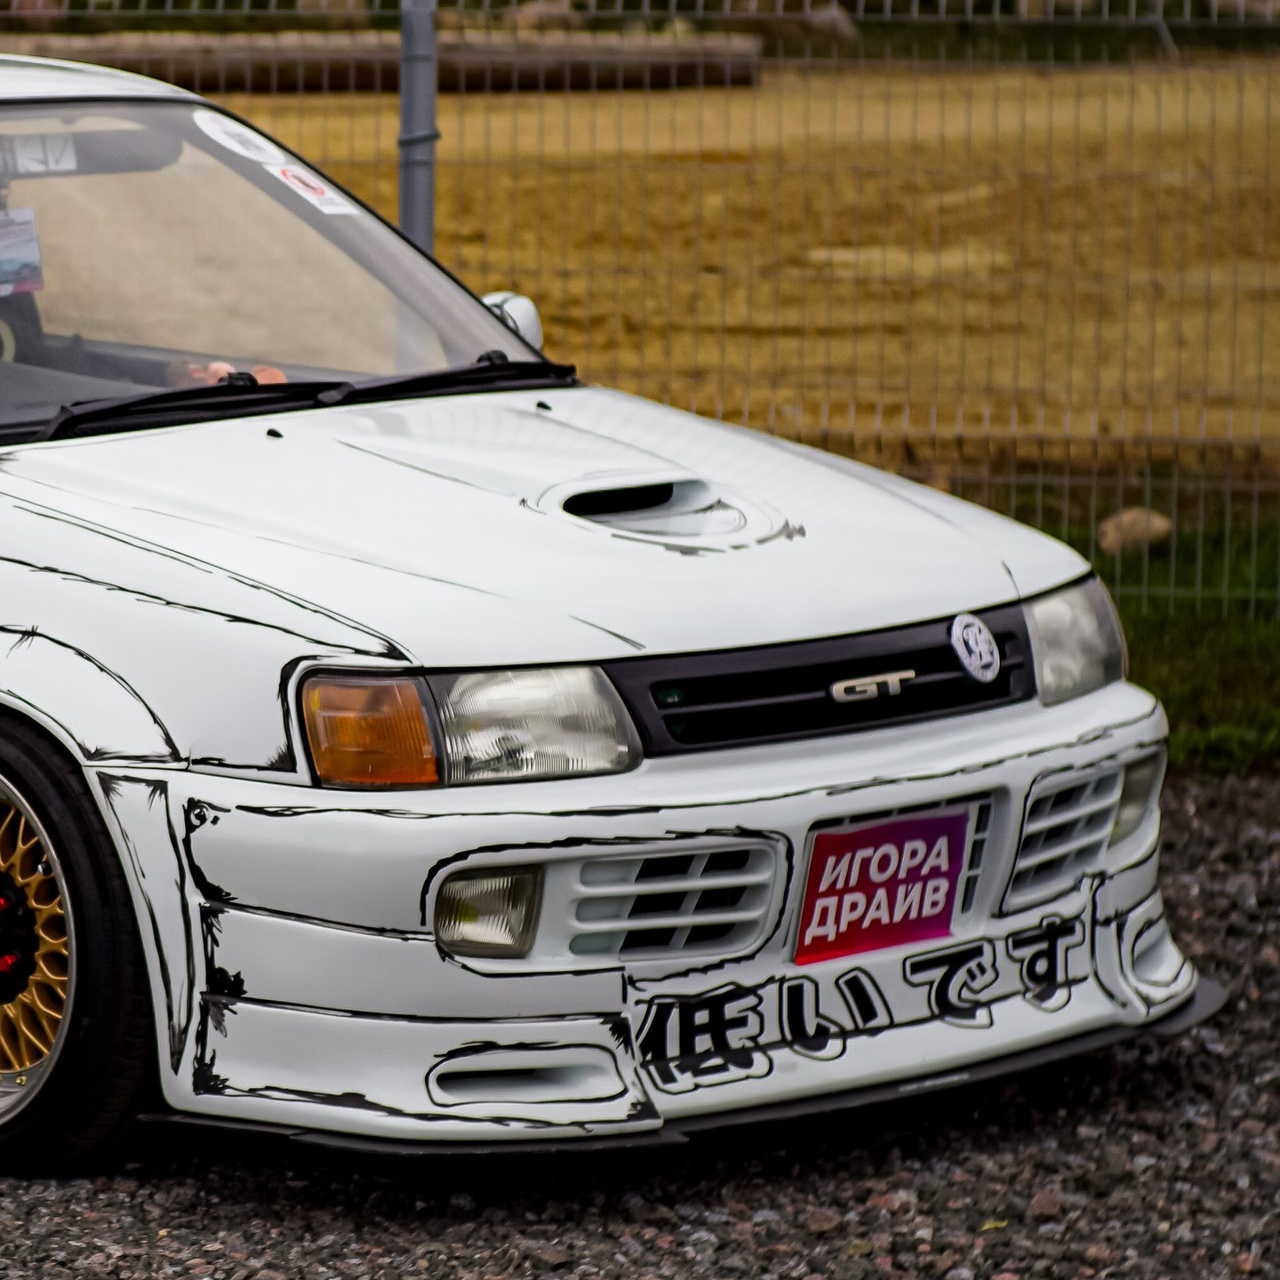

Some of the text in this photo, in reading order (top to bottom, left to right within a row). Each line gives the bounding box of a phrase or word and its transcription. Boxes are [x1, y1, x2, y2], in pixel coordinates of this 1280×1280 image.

[832, 669, 916, 703] GT
[818, 835, 950, 893] ИГОРА
[804, 876, 950, 946] ДРАЙВ
[637, 916, 1083, 1093] 低いです
